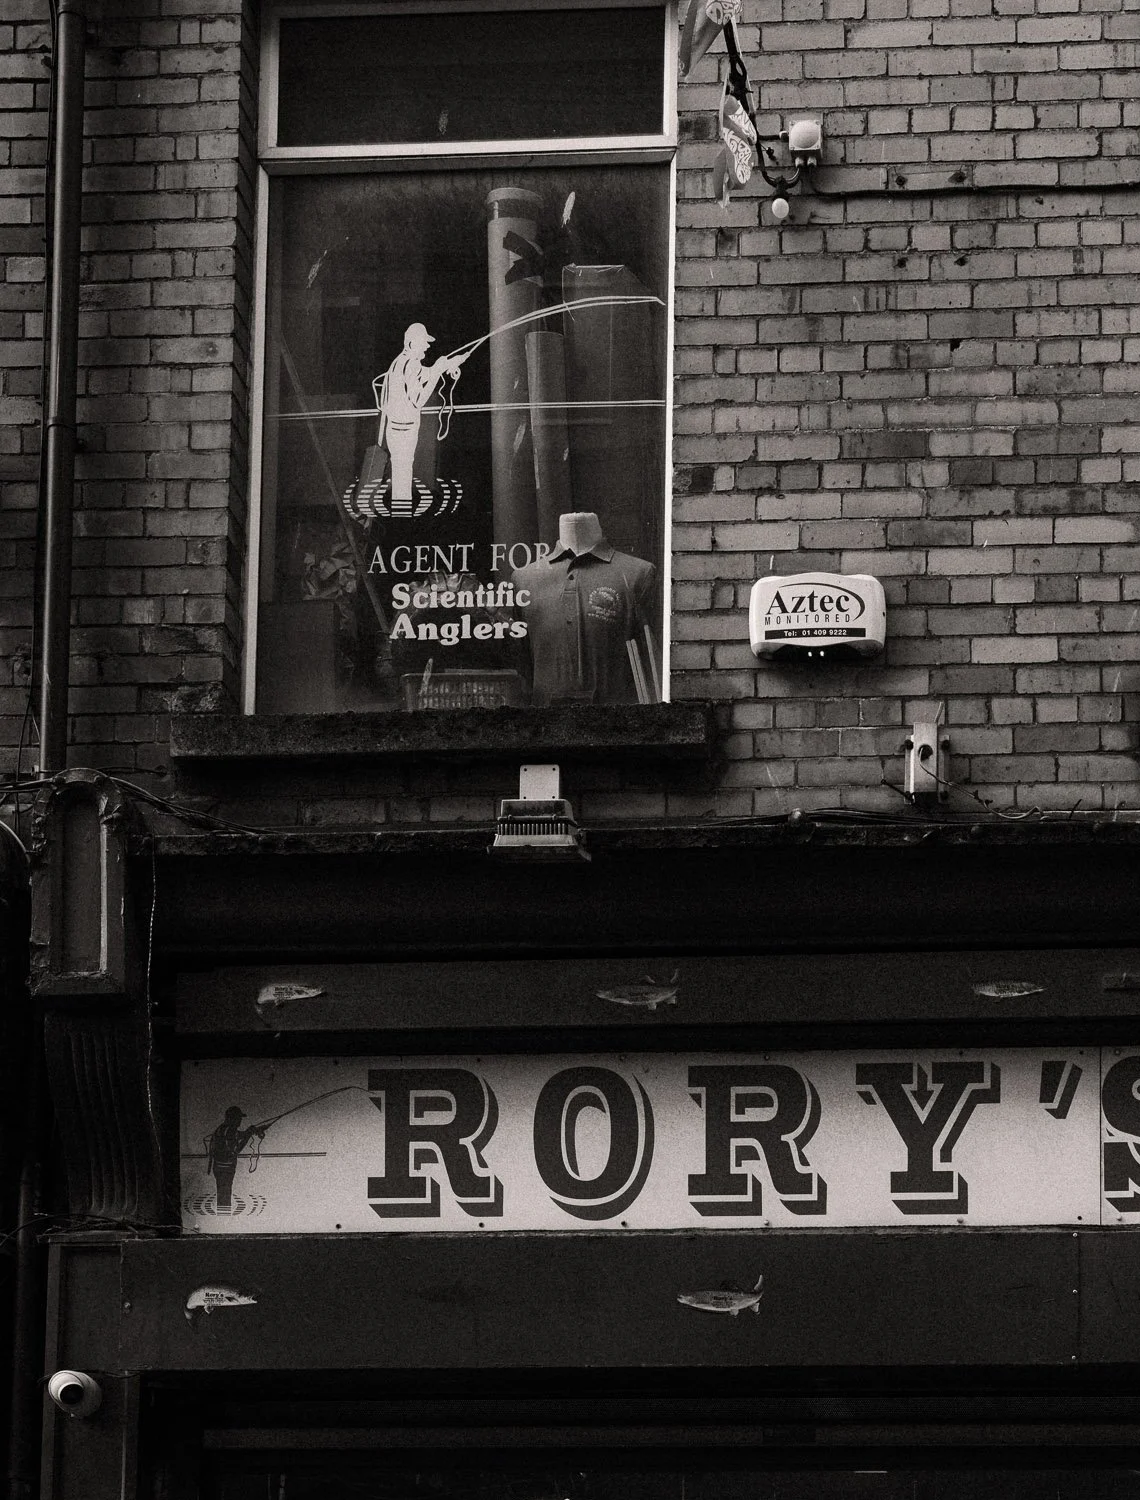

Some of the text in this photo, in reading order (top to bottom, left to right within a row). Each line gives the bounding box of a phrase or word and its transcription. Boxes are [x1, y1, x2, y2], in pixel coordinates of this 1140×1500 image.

[367, 542, 553, 575] AGENT FOR
[391, 580, 532, 611] Scientific
[765, 589, 851, 616] Aztec
[389, 613, 529, 647] Anglers
[764, 614, 851, 626] MONITORED
[814, 629, 828, 637] 409
